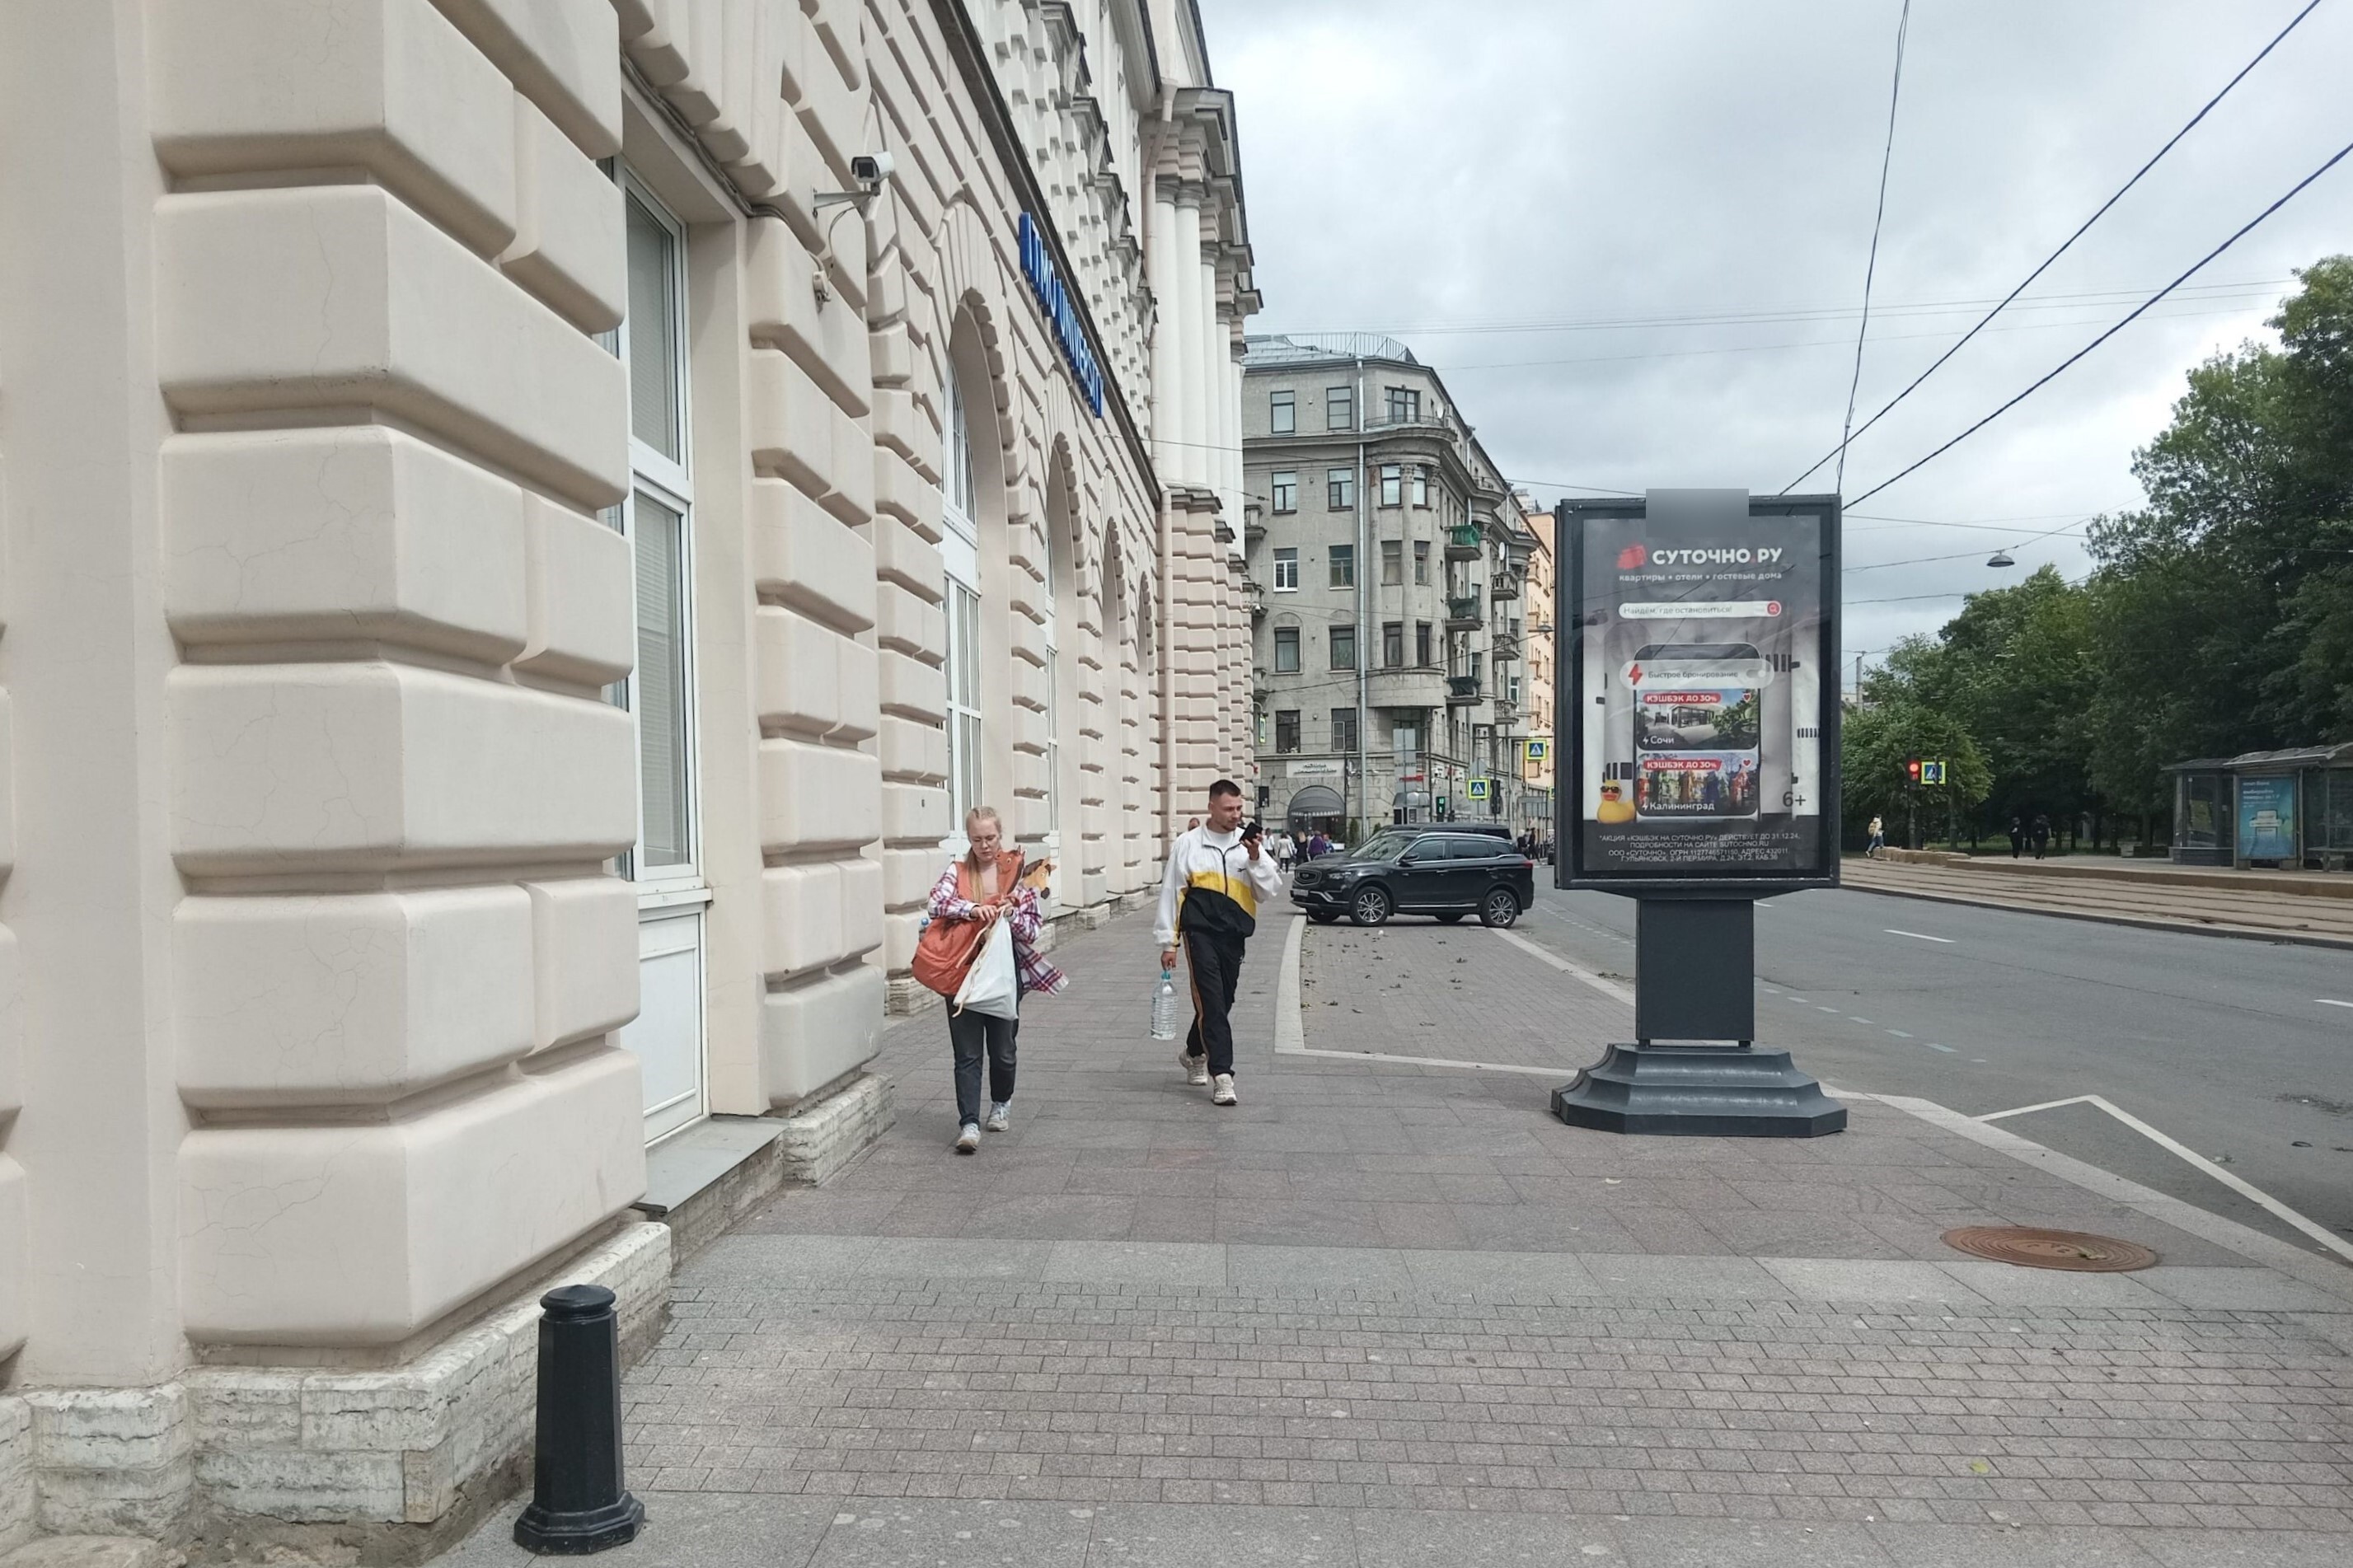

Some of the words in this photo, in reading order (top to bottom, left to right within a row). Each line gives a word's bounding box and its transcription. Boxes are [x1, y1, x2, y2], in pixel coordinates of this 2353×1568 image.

[1652, 548, 1783, 565] СУТОЧНО.РУ
[1619, 574, 1666, 583] квартиры
[1757, 572, 1782, 581] дома
[1648, 671, 1681, 679] Быстрое
[1682, 669, 1738, 680] бронирование
[1647, 695, 1685, 703] КЭШБЭК
[1685, 695, 1699, 703] ДО
[1699, 694, 1718, 702] 30%
[1650, 736, 1675, 744] Сочи
[1647, 761, 1685, 770] КЭШБЭК
[1685, 761, 1699, 770] ДО
[1699, 761, 1718, 769] 30%
[1782, 791, 1807, 807] 6+
[1650, 802, 1715, 812] Калининград
[1760, 832, 1770, 840] ДО
[1629, 841, 1682, 850] ПОДРОБНОСТИ
[1719, 840, 1769, 848] SUTOCHNO.RU
